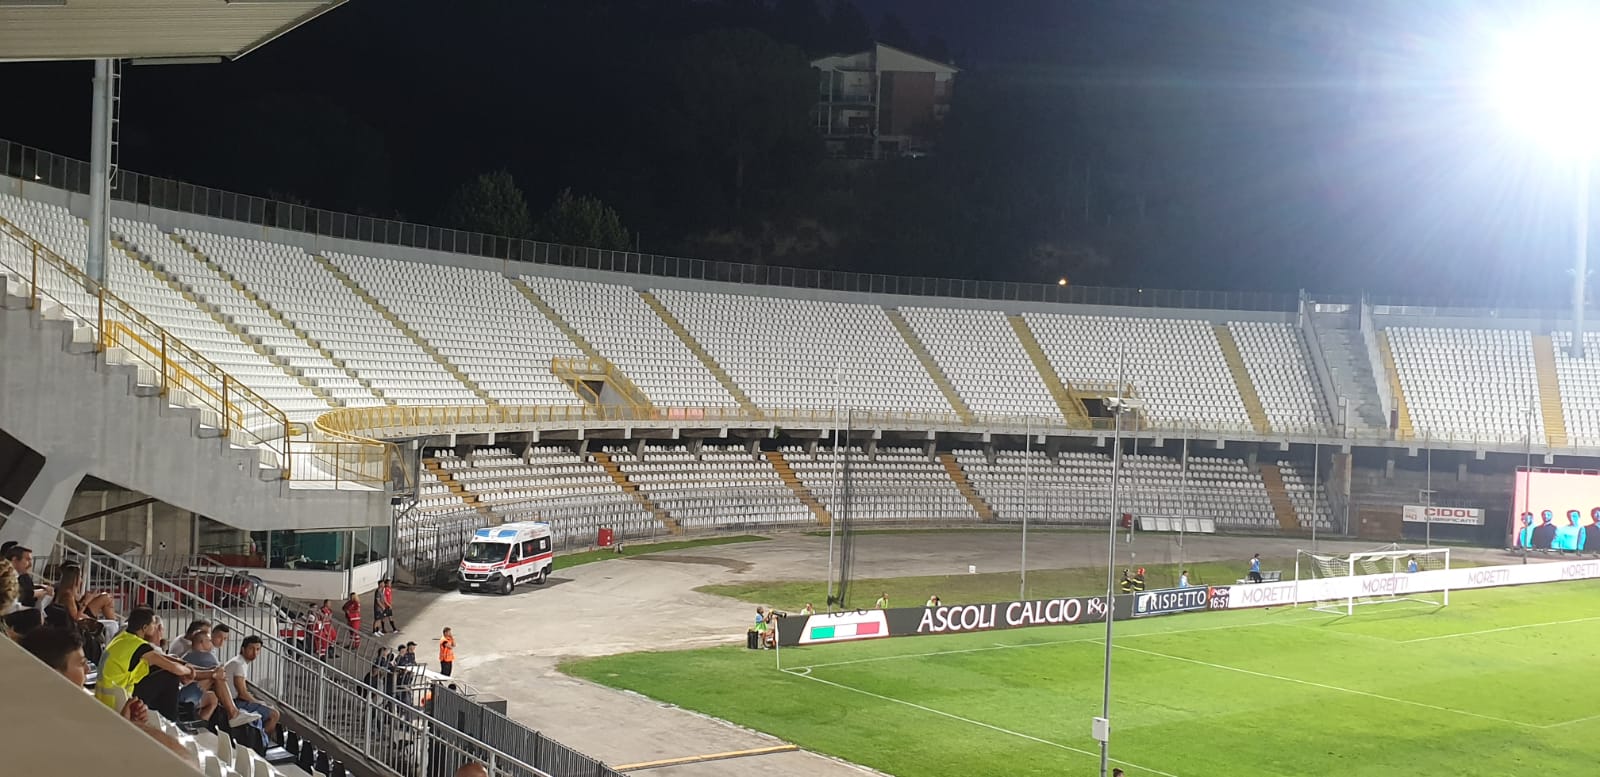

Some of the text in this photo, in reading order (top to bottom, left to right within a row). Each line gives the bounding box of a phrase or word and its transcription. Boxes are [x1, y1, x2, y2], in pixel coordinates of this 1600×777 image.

[1424, 508, 1479, 518] CIDOL
[1467, 569, 1510, 585] MORETTI
[1150, 590, 1206, 610] RISPETTO
[1209, 597, 1229, 608] 16:51
[1241, 585, 1297, 603] MORETTI
[917, 604, 996, 632] ASCOLI
[1005, 599, 1081, 625] CALCIO
